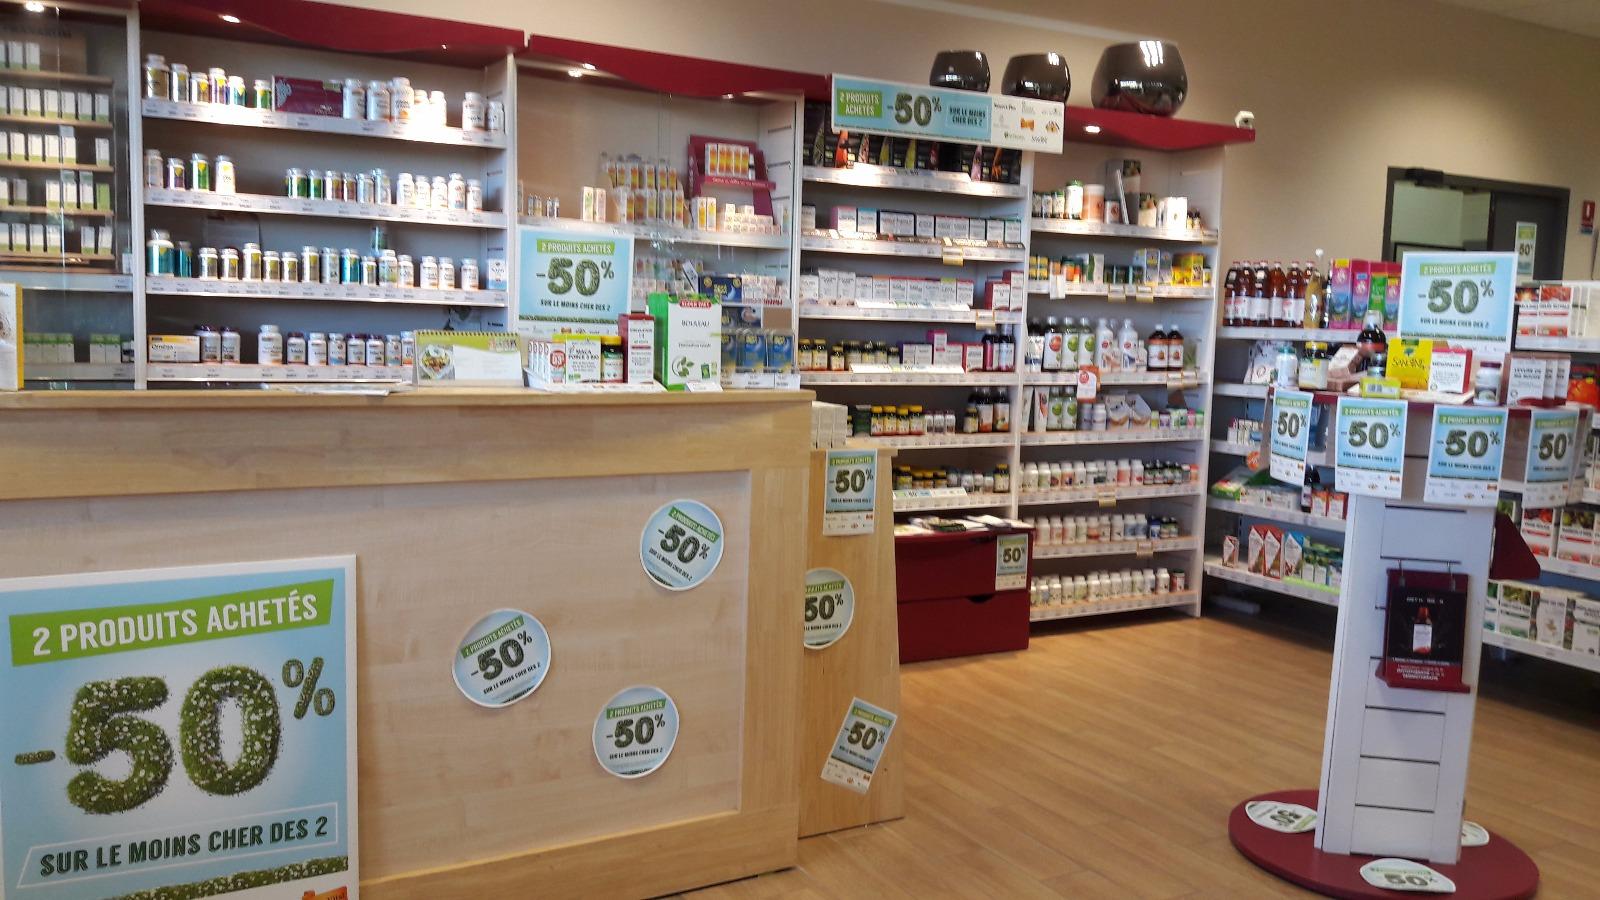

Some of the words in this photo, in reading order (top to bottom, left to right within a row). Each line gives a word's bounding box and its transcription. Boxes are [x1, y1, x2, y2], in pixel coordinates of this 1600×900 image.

[846, 92, 879, 104] PRODUITS
[887, 92, 942, 126] -50%
[541, 243, 546, 252] 2
[548, 242, 580, 254] PRODUITS
[536, 257, 614, 296] -50%
[1429, 265, 1460, 274] PRODUITS
[1418, 279, 1494, 314] -50%
[1274, 411, 1307, 438] -50%
[1341, 420, 1400, 449] -50%
[1436, 429, 1500, 458] -50%
[829, 468, 874, 493] -50%
[658, 524, 710, 564] -50%
[32, 627, 51, 656] 2
[60, 608, 198, 652] PRODUITS
[206, 589, 318, 633] ACHETÉS
[470, 630, 532, 680] -50%
[15, 656, 336, 816] -50%
[606, 713, 666, 748] -50%
[844, 721, 886, 750] -50%
[40, 847, 89, 878] SUR
[95, 843, 122, 868] LE
[128, 833, 201, 864] MOINS
[207, 824, 264, 858] CHER
[270, 818, 309, 844] DES
[314, 816, 328, 836] 2
